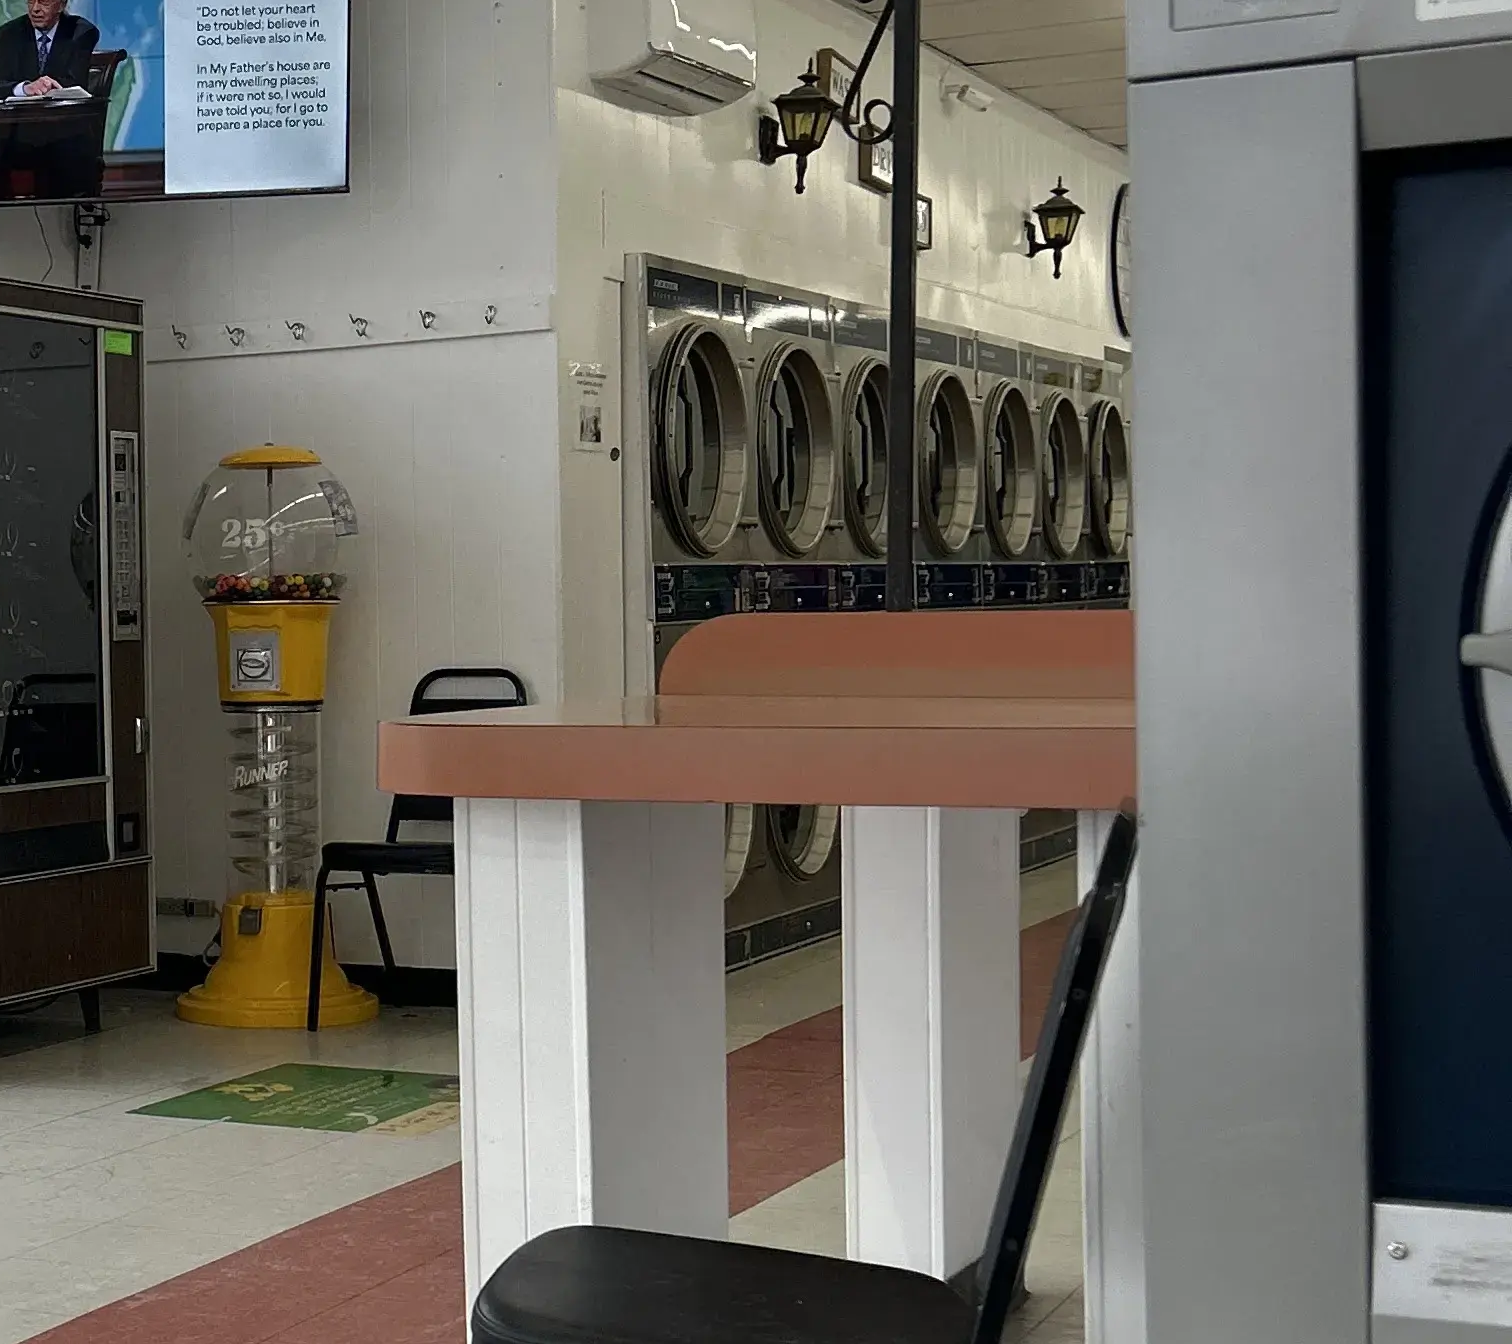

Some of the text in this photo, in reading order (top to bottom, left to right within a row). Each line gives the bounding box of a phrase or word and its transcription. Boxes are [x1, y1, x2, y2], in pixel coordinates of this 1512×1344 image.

[221, 6, 240, 16] not
[242, 5, 256, 15] let
[258, 6, 284, 17] your
[286, 4, 316, 14] heart
[197, 17, 320, 32] be troubled; believe in
[197, 35, 224, 46] God,
[227, 34, 266, 45] believe
[269, 33, 291, 44] also
[293, 32, 303, 42] in
[197, 61, 331, 76] In My Father's house are
[197, 75, 319, 90] many dwelling places;
[197, 92, 205, 103] if
[206, 92, 214, 102] it
[216, 93, 244, 102] were
[247, 91, 265, 101] not
[268, 91, 283, 101] so,
[291, 88, 326, 99] would
[197, 106, 223, 117] have
[226, 105, 247, 116] told
[276, 103, 292, 114] for
[299, 104, 314, 115] go
[317, 102, 328, 112] to
[197, 117, 325, 133] prepare a place for you.
